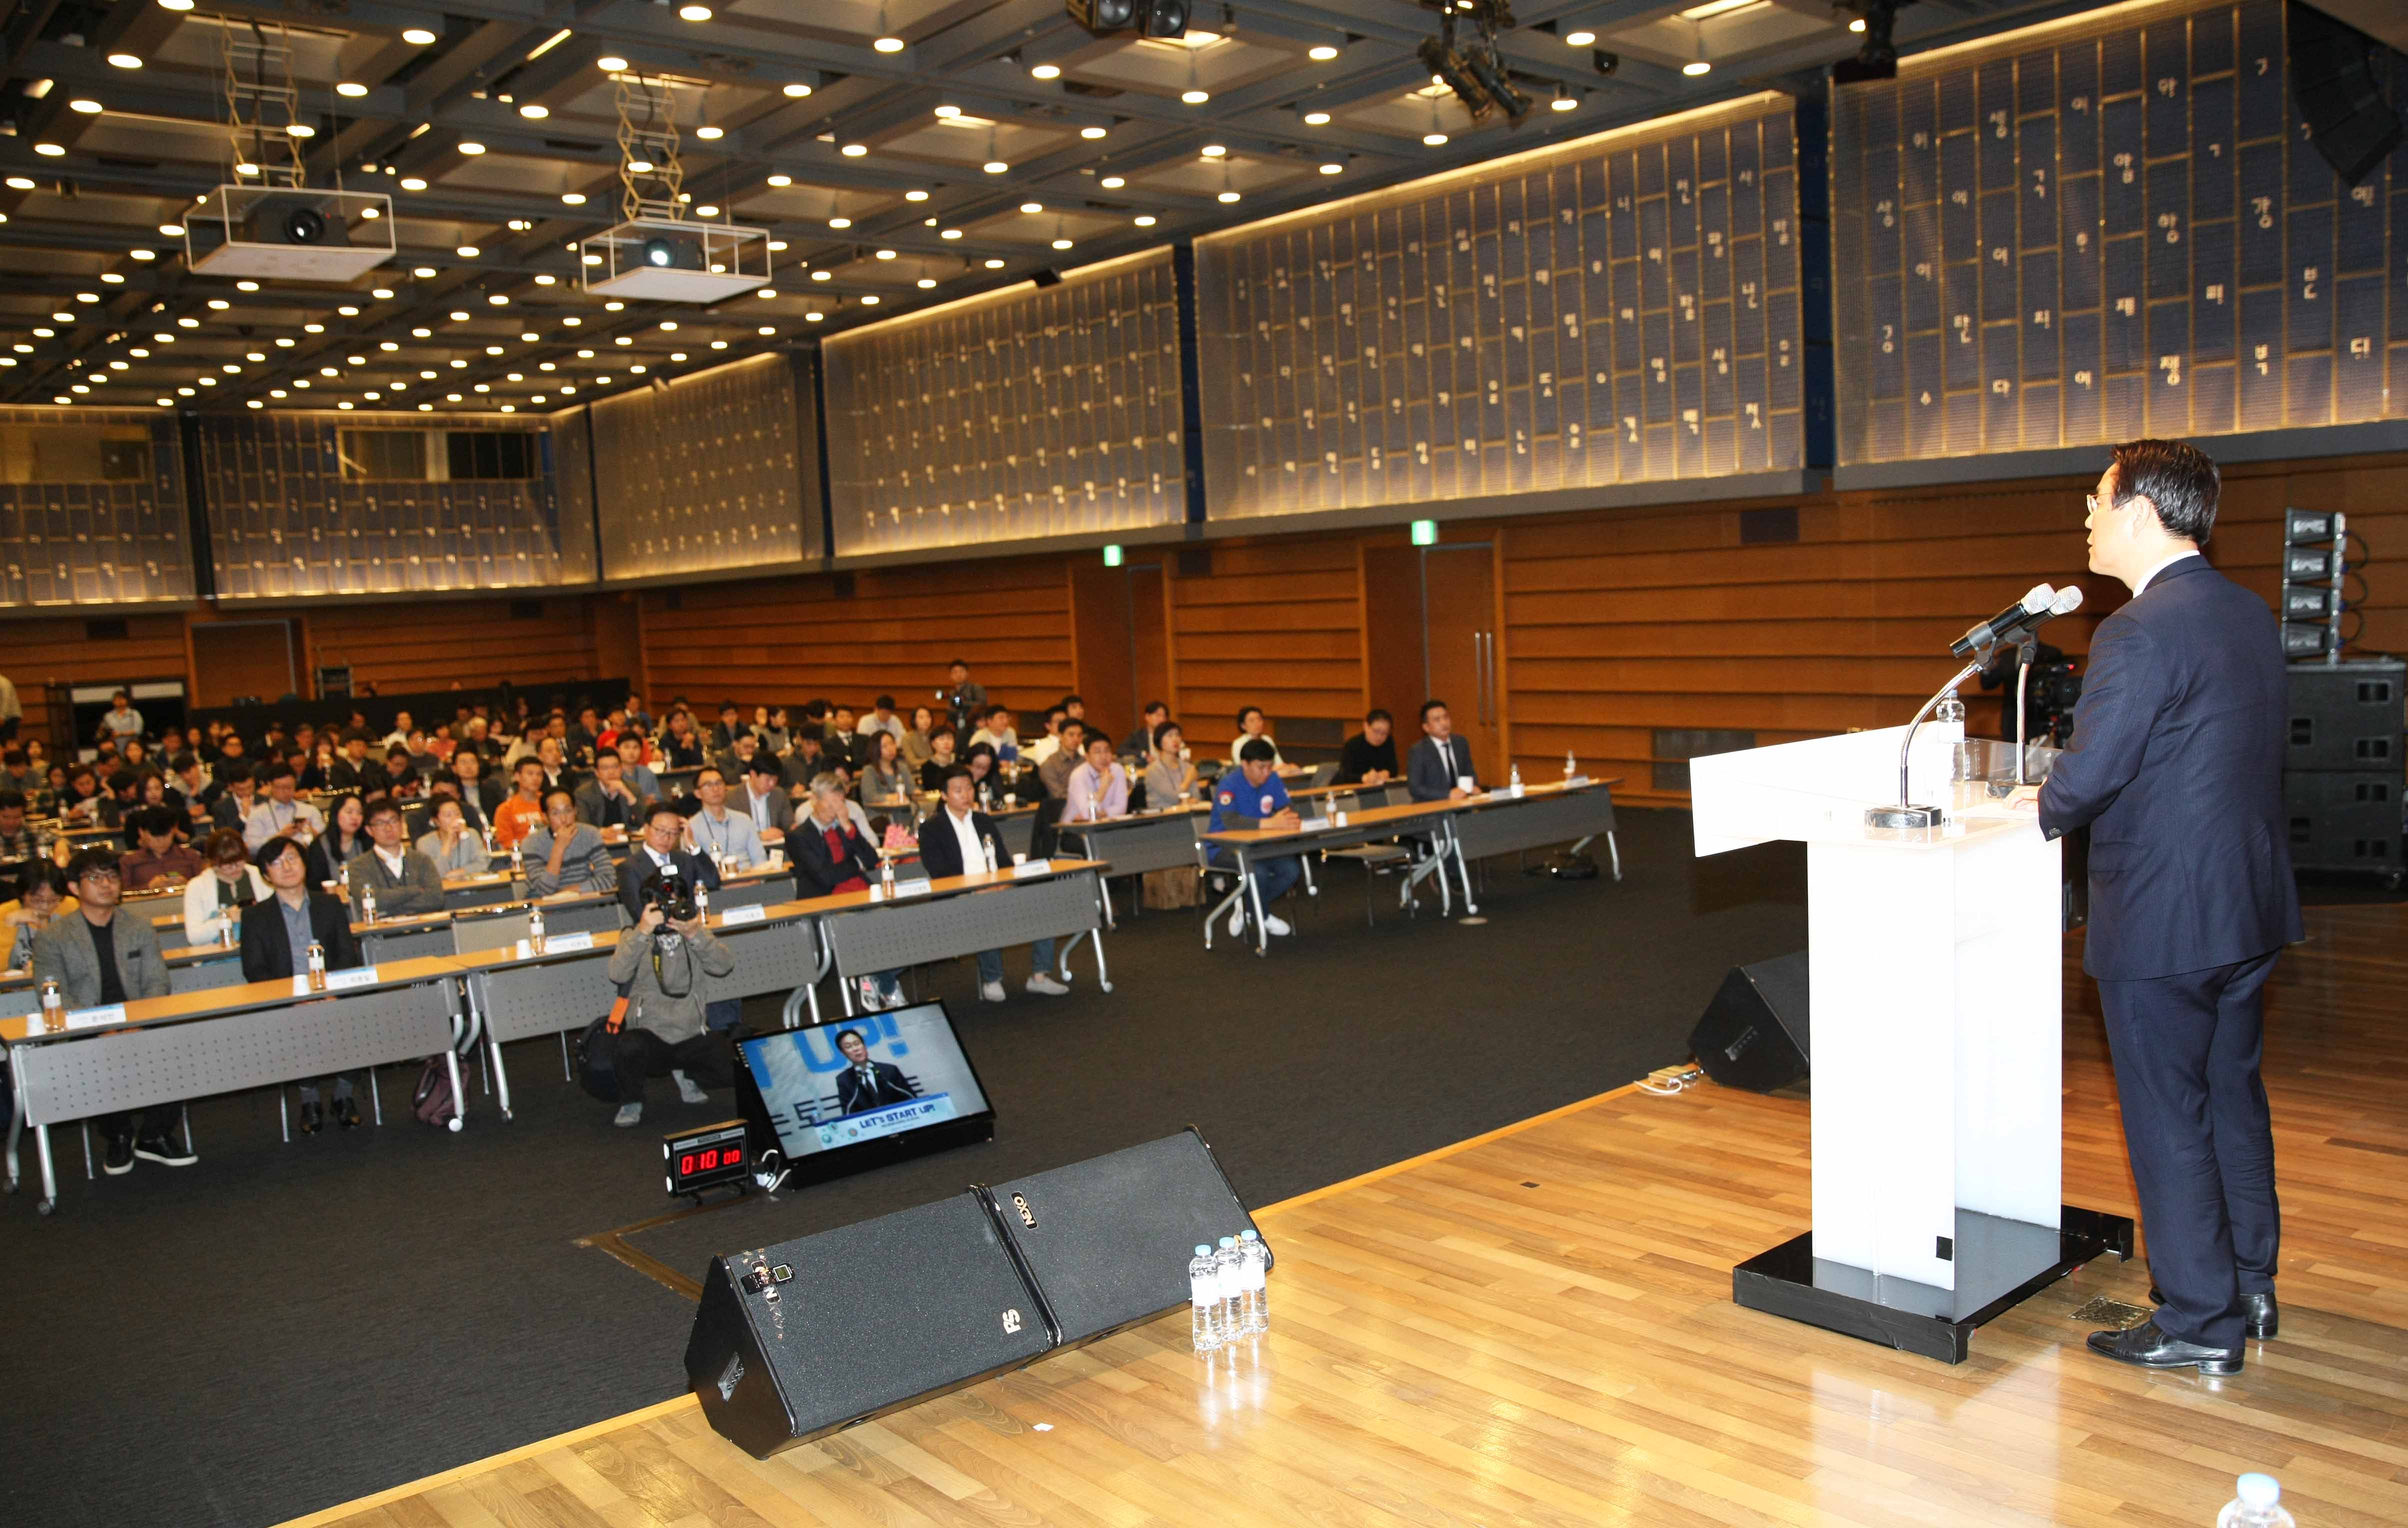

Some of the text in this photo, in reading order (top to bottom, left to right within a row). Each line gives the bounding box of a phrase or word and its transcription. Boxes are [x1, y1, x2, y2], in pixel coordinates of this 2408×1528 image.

[886, 1107, 917, 1122] START
[919, 1104, 935, 1114] UP!
[1014, 1196, 1036, 1226] NEXO
[1002, 1309, 1021, 1334] PS
